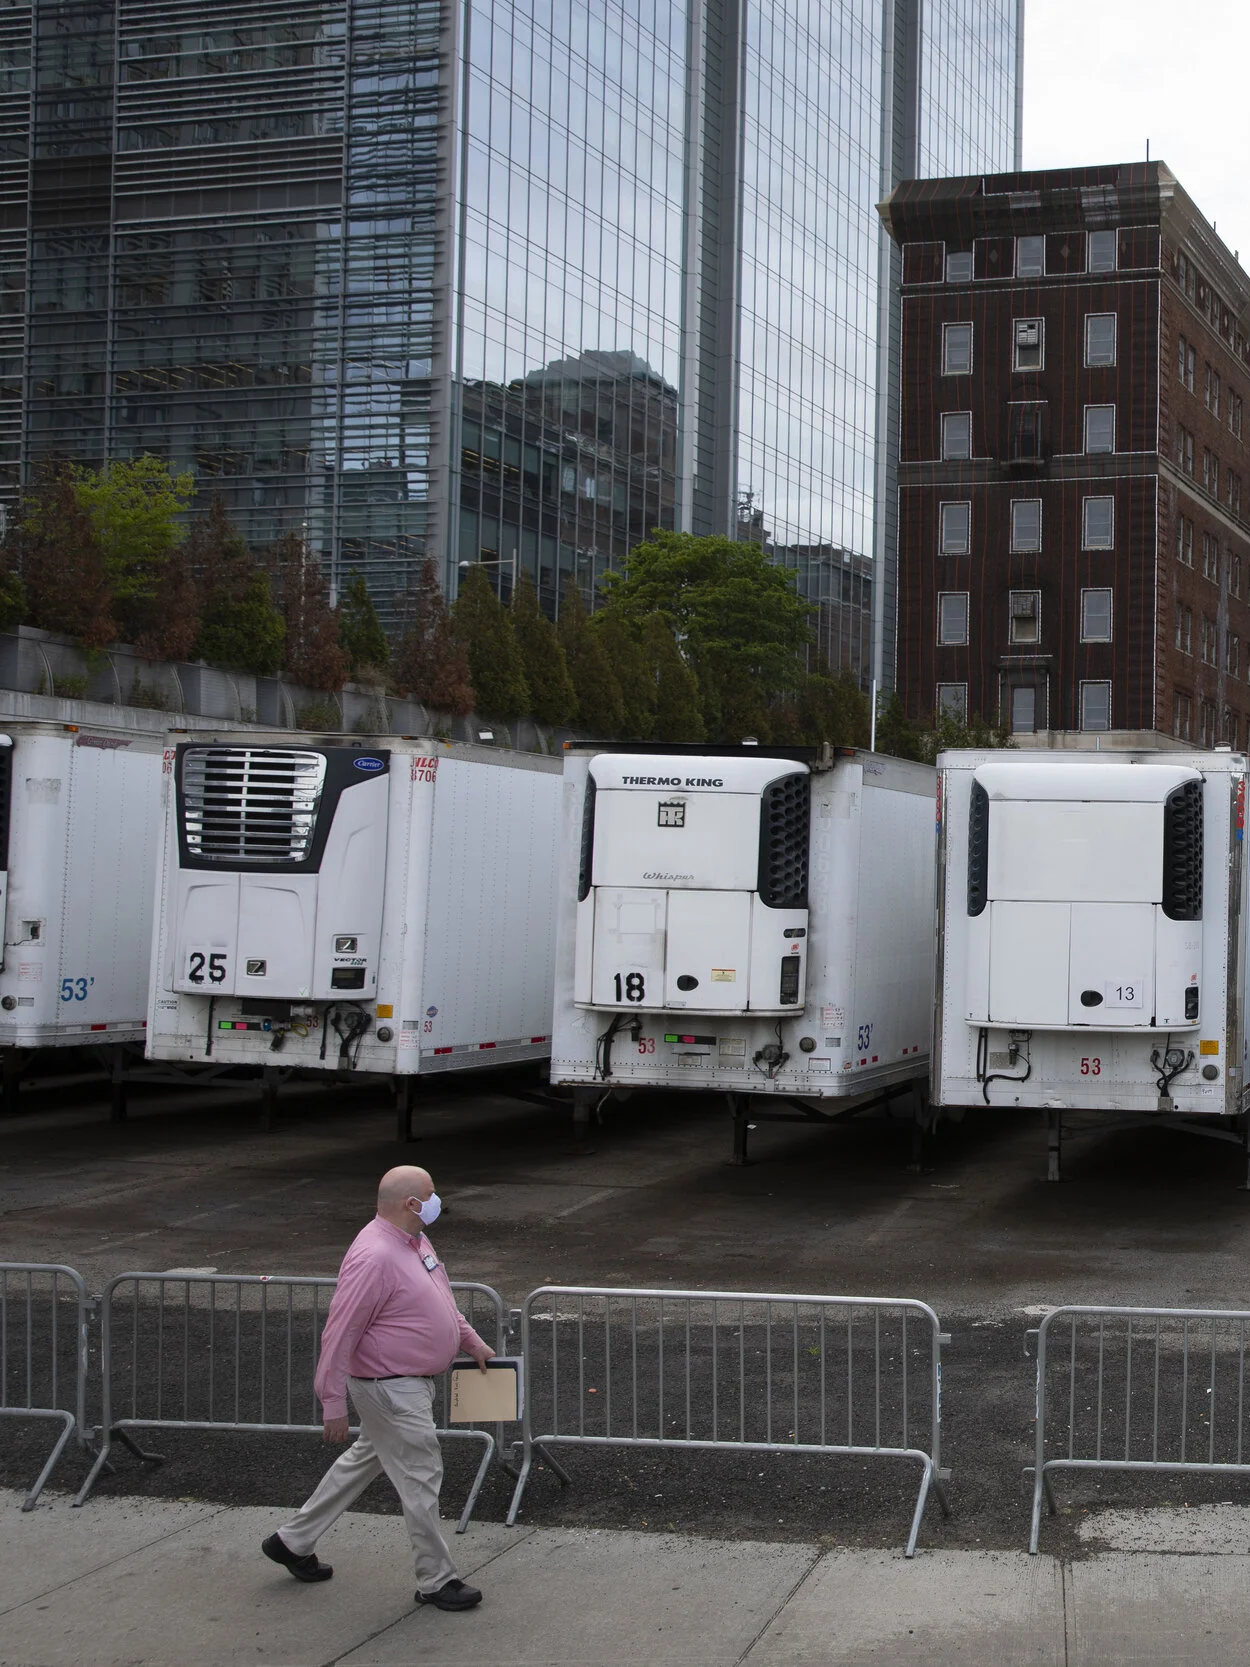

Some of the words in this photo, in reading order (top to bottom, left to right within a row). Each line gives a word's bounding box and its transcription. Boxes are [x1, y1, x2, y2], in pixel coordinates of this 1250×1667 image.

[357, 760, 381, 768] Carrier
[622, 776, 682, 786] THERMO
[685, 778, 724, 787] KING
[188, 952, 227, 983] 25
[614, 972, 645, 1002] 18
[1115, 986, 1135, 1001] 13
[306, 1015, 319, 1028] 53
[424, 1020, 433, 1032] 53
[638, 1037, 655, 1054] 53
[1080, 1058, 1101, 1075] 53
